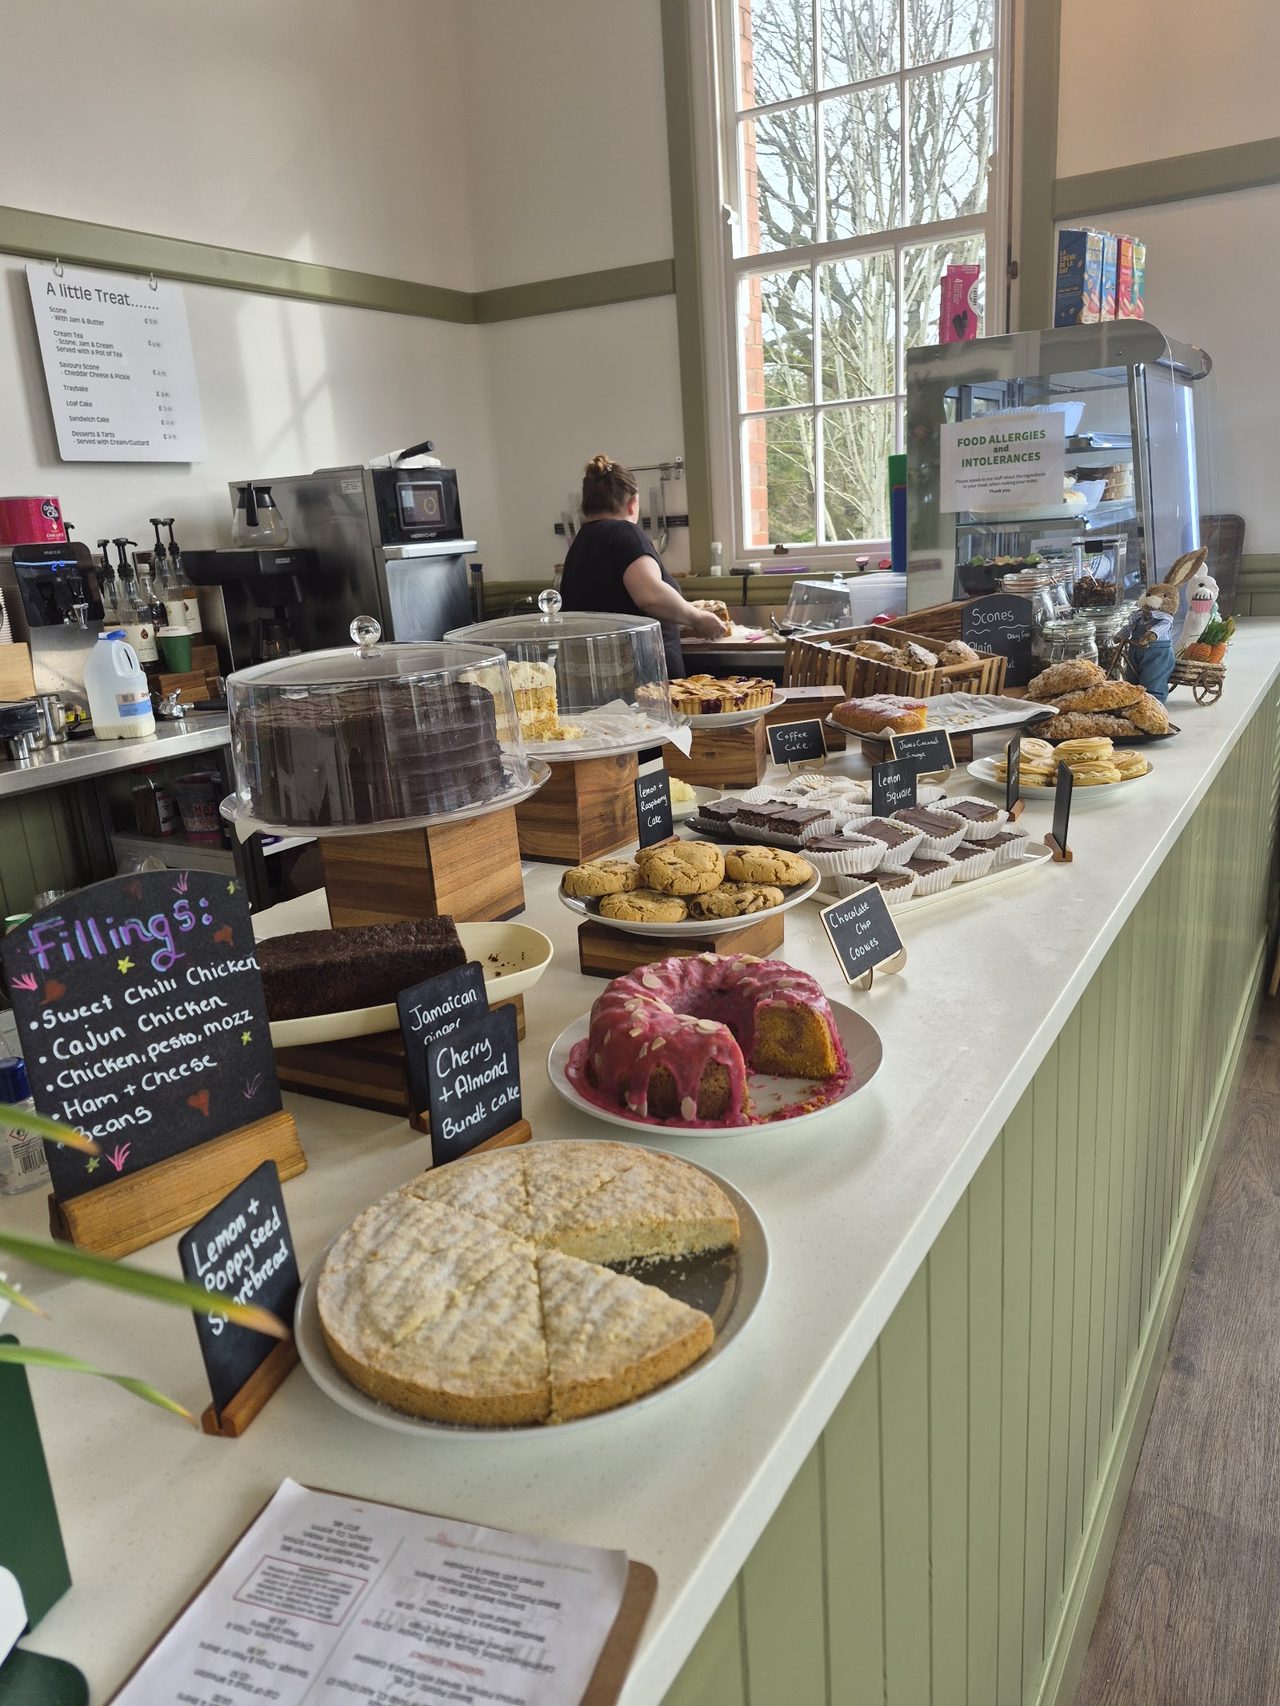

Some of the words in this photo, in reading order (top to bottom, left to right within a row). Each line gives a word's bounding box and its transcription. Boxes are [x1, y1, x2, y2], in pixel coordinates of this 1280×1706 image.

[47, 282, 55, 295] A
[60, 284, 92, 301] little
[49, 306, 67, 314] Scone
[54, 314, 69, 322] With
[86, 318, 105, 326] Butter
[53, 330, 73, 338] Cream
[56, 345, 77, 353] Served
[95, 349, 106, 357] Pot
[59, 361, 82, 370] Savoury
[64, 369, 88, 377] Cheddar
[88, 371, 109, 379] Cheese
[63, 384, 89, 392] Traybake
[71, 430, 96, 438] Desserts
[957, 436, 987, 448] FOOD
[988, 429, 1046, 445] ALLERGIES
[993, 445, 1009, 453] and
[961, 452, 1041, 468] INTOLERANCES
[972, 608, 1014, 626] Scones
[776, 731, 808, 742] Coffee
[784, 742, 809, 751] Cake
[648, 815, 662, 827] Cake
[829, 901, 870, 928] Chocolate
[28, 897, 213, 972] Fillings:
[855, 920, 872, 935] Chip
[849, 937, 879, 961] Cookies
[42, 994, 114, 1030] Sweet
[186, 956, 261, 986] Chicken
[409, 988, 478, 1031] Jamaican
[52, 1024, 127, 1062] Cajun
[137, 995, 229, 1033] Chicken
[56, 1051, 147, 1089] Chicken,
[147, 1029, 203, 1064] pesto,
[204, 1008, 254, 1038] mozz
[436, 1038, 492, 1078] Cherry
[63, 1093, 119, 1121] Ham
[124, 1084, 137, 1096] +
[140, 1053, 219, 1092] Cheese
[441, 1105, 488, 1140] Bundt
[491, 1084, 521, 1112] cake
[72, 1105, 153, 1141] Beans
[250, 1205, 282, 1250] seed
[191, 1213, 247, 1277] Lemon
[247, 1197, 260, 1215] +
